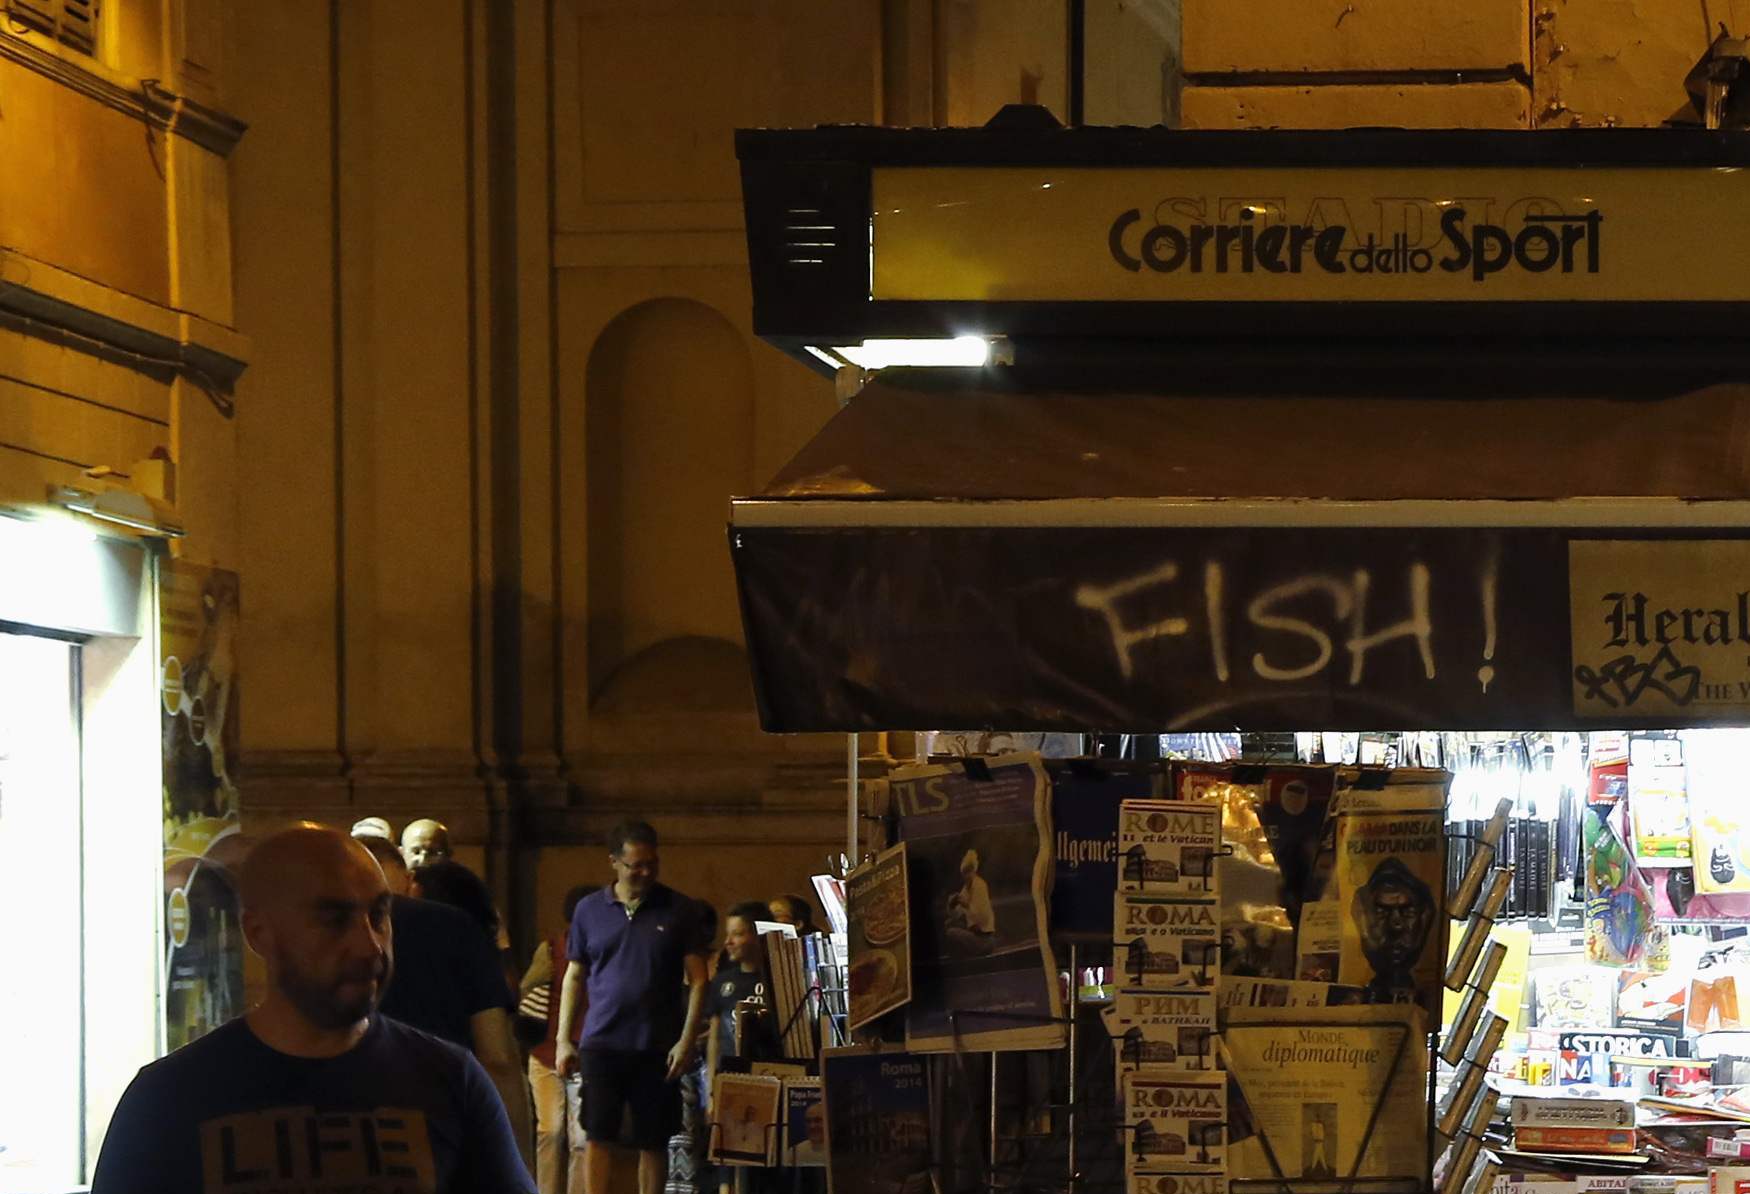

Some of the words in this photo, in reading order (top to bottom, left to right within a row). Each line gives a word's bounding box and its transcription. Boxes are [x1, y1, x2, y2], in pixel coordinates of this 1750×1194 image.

[1108, 207, 1347, 274] Corriere
[1348, 231, 1433, 275] dello
[1440, 207, 1603, 282] Sport
[1124, 812, 1217, 836] ROME
[1056, 832, 1117, 865] llgemei
[1169, 834, 1214, 845] Vatican
[1126, 905, 1216, 926] ROMA
[1134, 996, 1201, 1016] РИМ
[1298, 1031, 1344, 1044] MONDE
[1262, 1041, 1380, 1069] diplomatique
[881, 1061, 921, 1076] Roma
[1132, 1088, 1222, 1108] ROMA
[219, 1115, 418, 1185] LIFE
